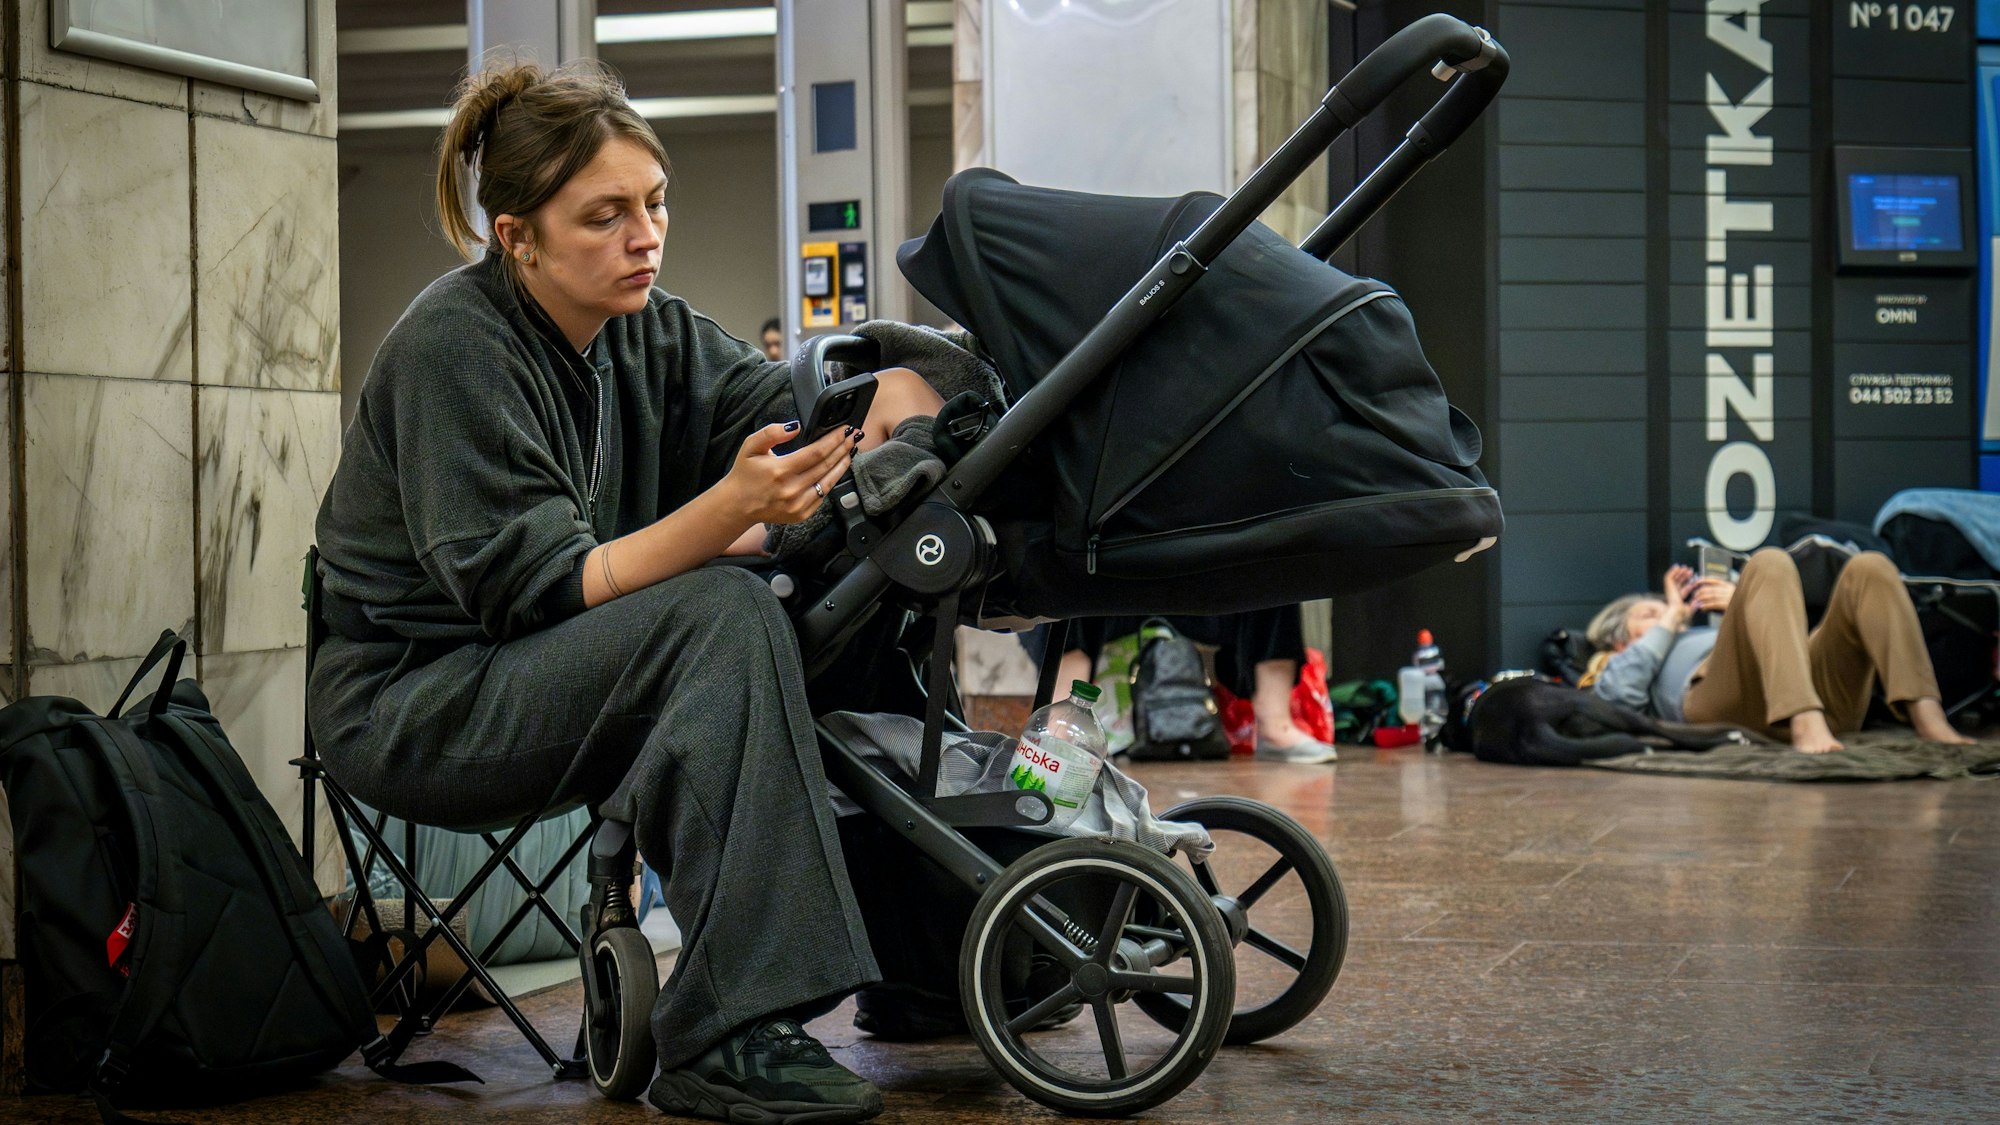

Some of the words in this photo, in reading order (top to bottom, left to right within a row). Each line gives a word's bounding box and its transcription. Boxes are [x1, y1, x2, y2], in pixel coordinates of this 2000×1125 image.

[1705, 0, 1776, 552] OZETKA
[1139, 284, 1161, 306] BALIOS
[1158, 279, 1165, 287] S
[1876, 308, 1917, 324] OMNI
[1849, 387, 1881, 404] 044
[1882, 387, 1912, 404] 502
[1913, 387, 1933, 404] 23
[1934, 387, 1953, 404] 52
